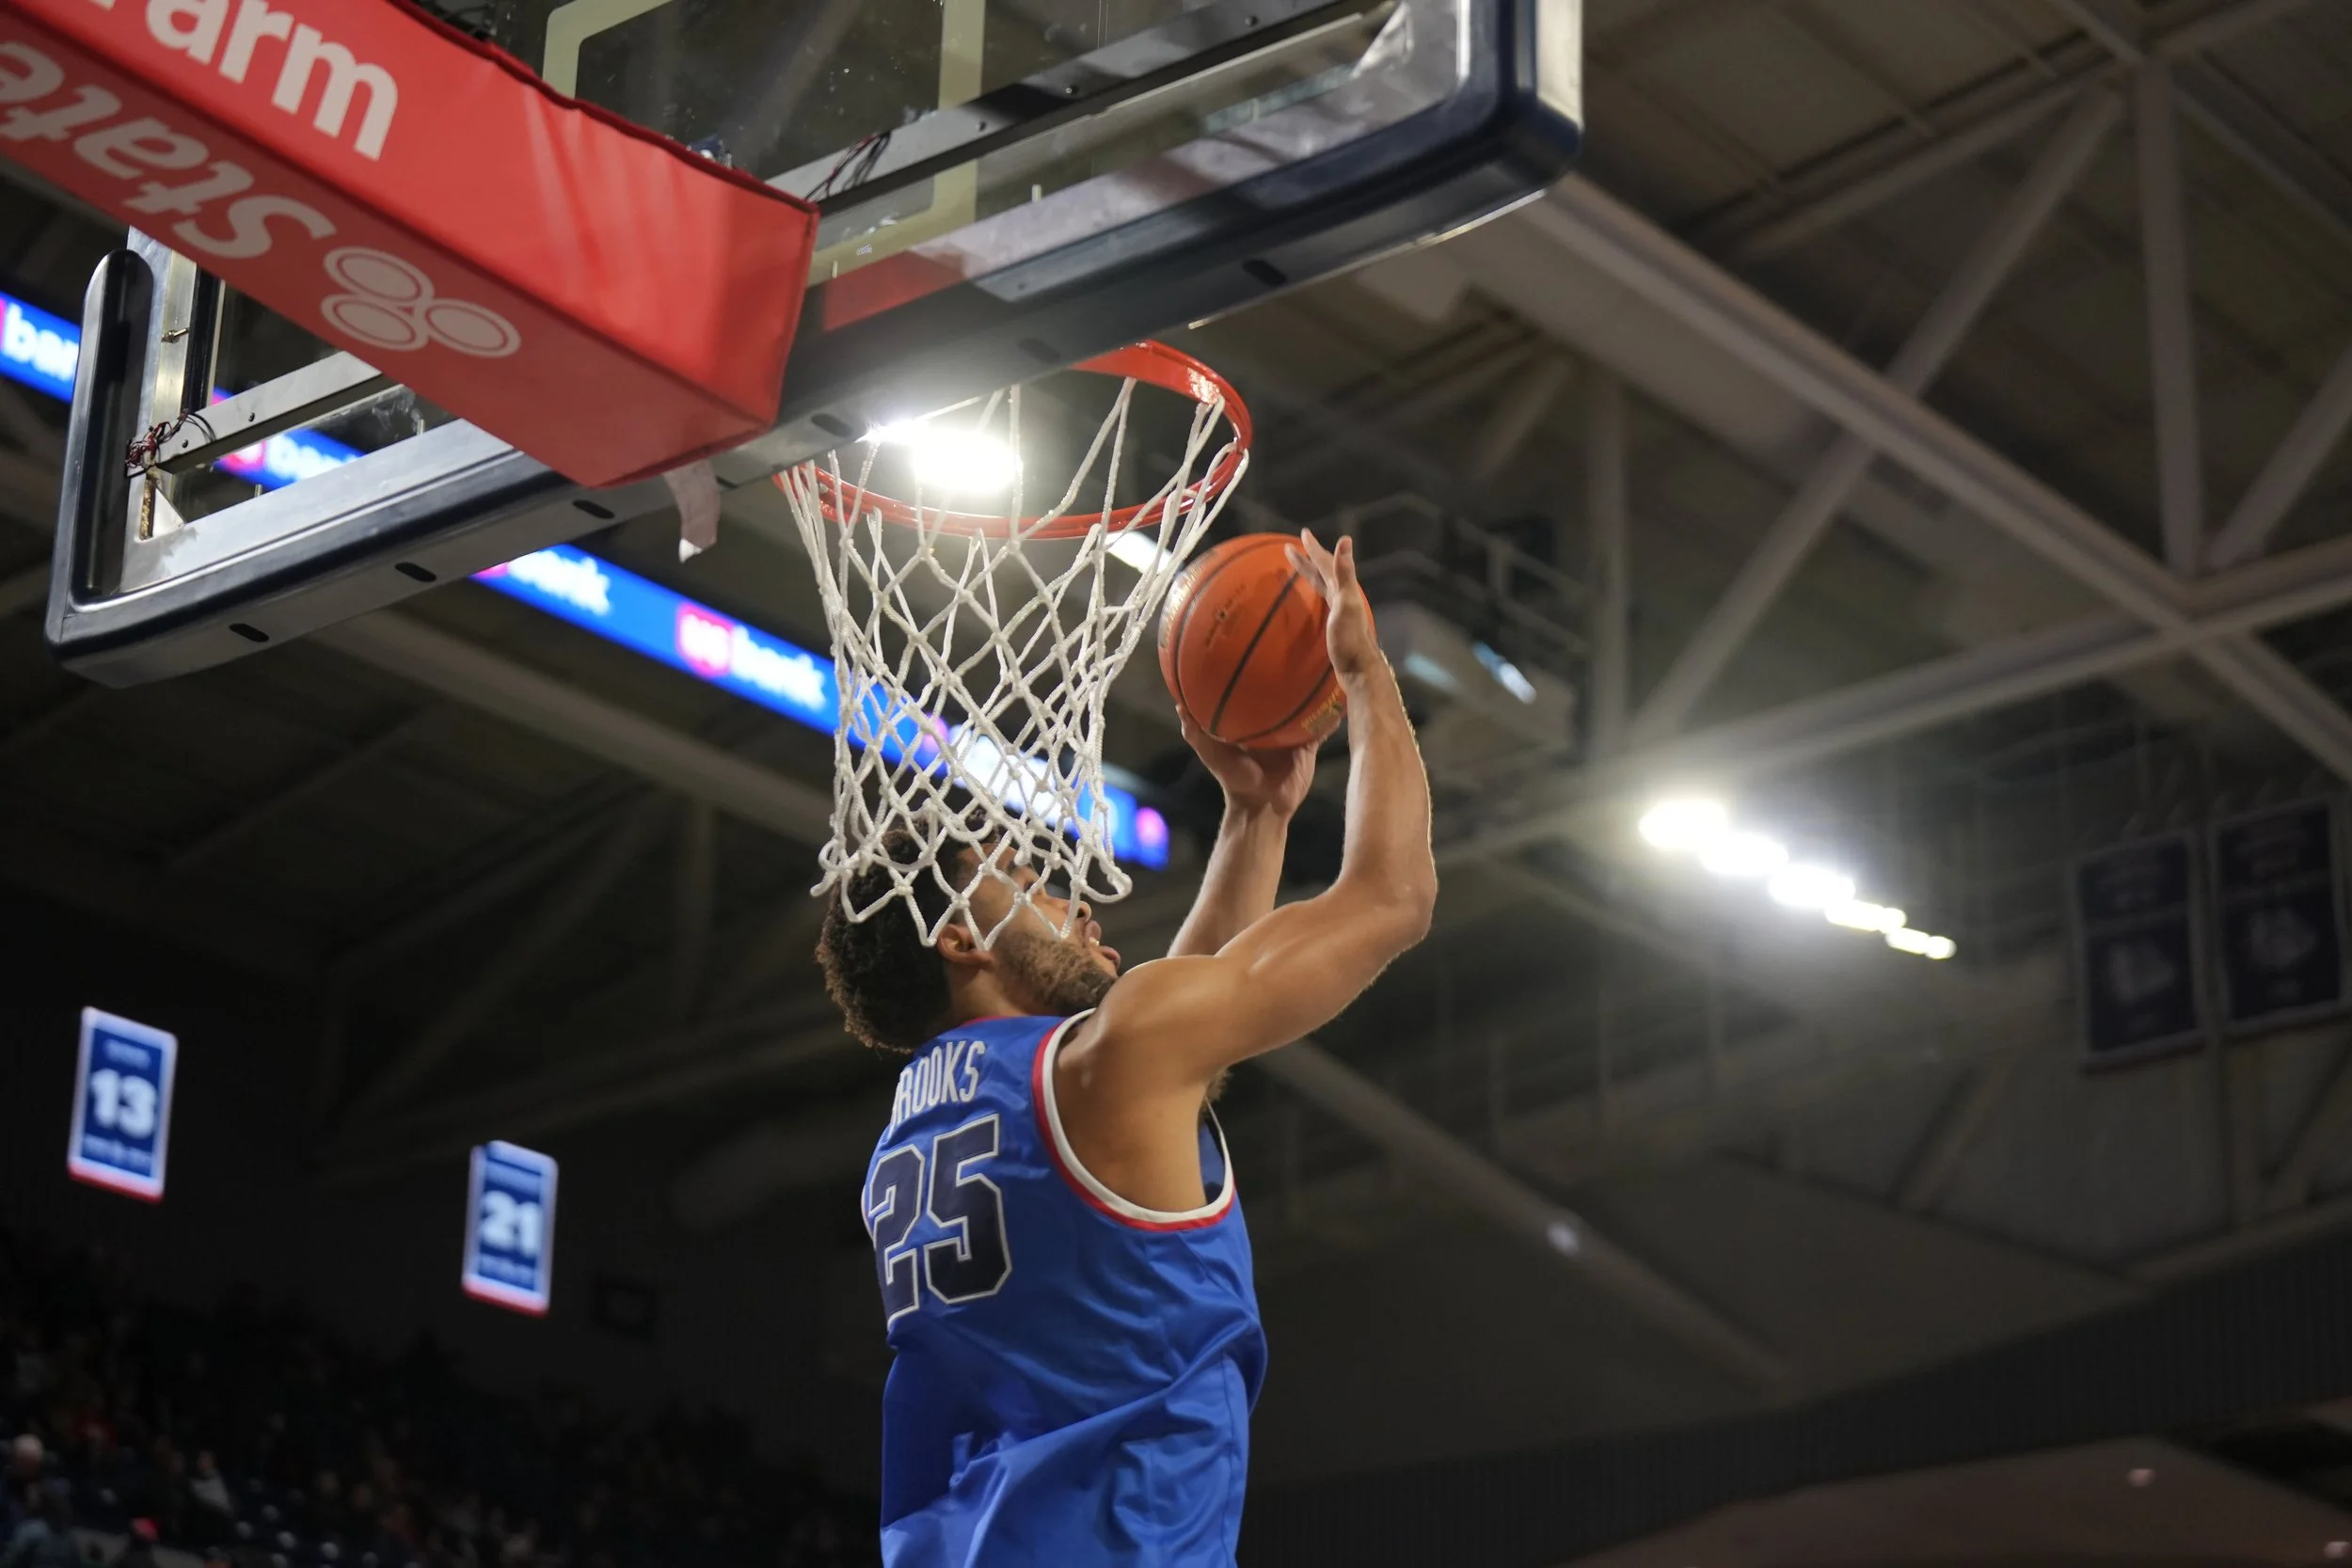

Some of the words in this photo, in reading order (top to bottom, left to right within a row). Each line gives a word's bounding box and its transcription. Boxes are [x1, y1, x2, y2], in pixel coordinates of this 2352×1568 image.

[86, 0, 399, 162] arm
[90, 1068, 158, 1139] 13
[888, 1040, 986, 1134] ROOKS
[480, 1189, 544, 1259] 21
[867, 1113, 1012, 1326] 25
